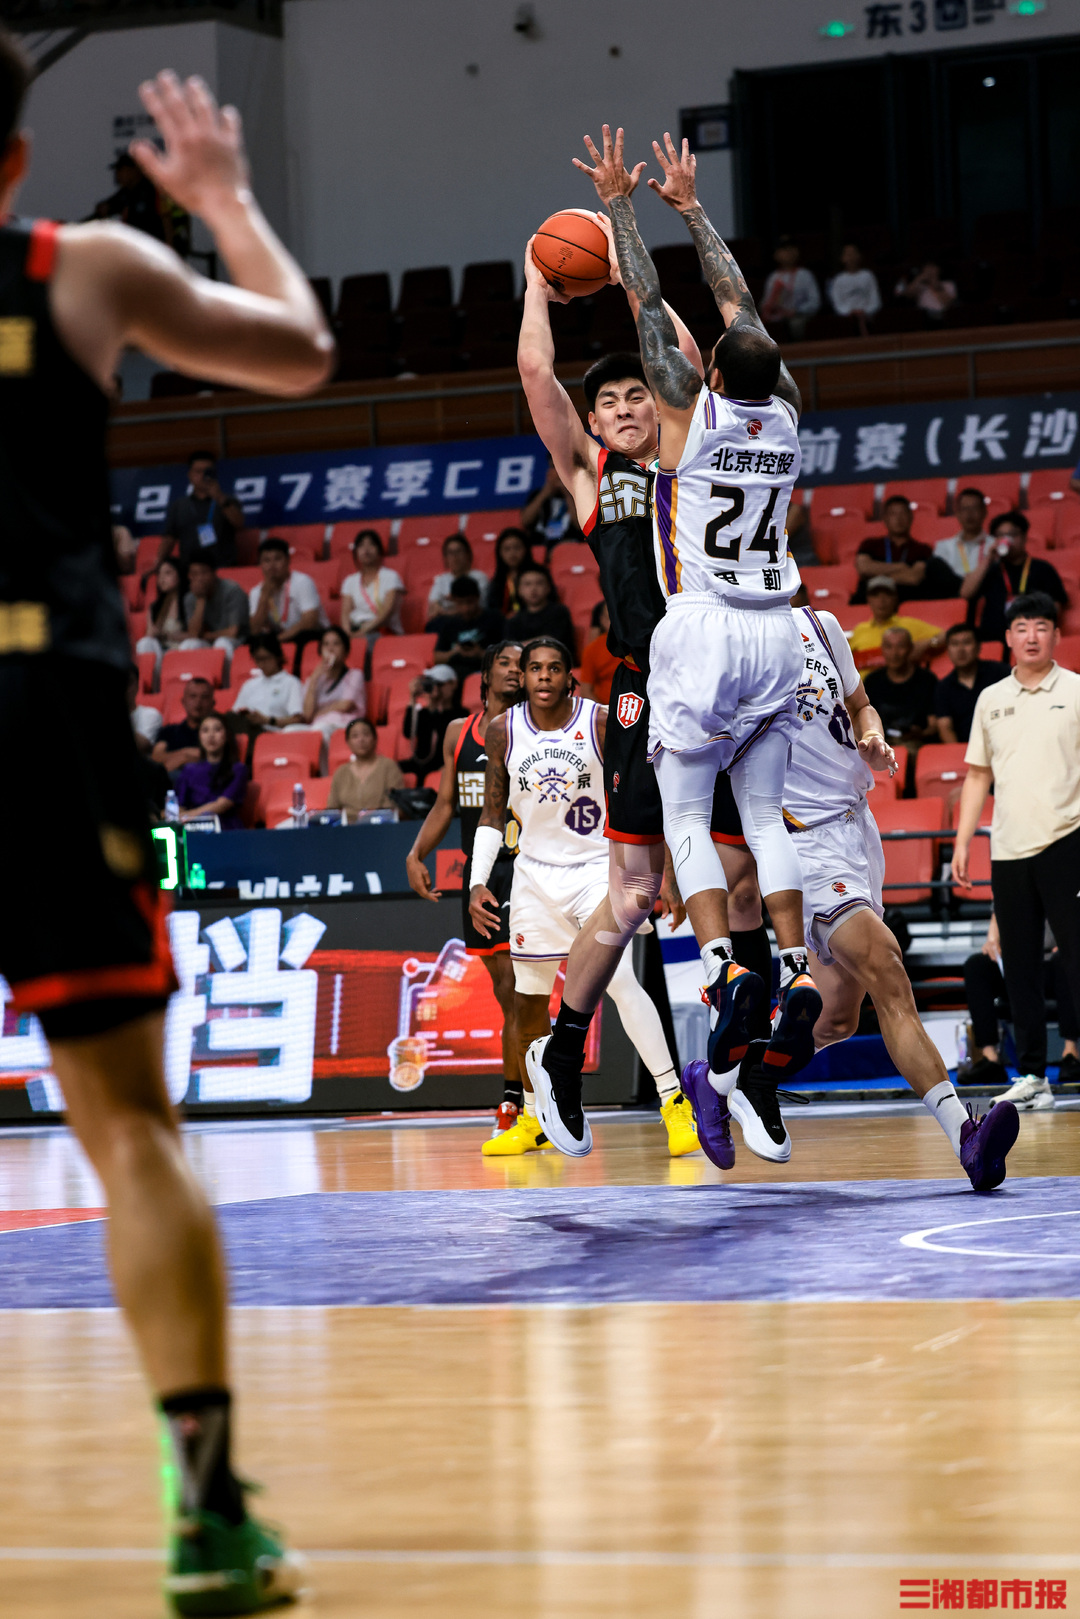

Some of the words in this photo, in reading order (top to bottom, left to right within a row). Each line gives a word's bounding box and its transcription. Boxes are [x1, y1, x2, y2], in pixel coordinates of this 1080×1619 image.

[710, 447, 795, 475] 北京控股
[704, 482, 781, 564] 24
[803, 657, 829, 677] ERS
[518, 751, 544, 775] ROYAL
[544, 748, 588, 772] FIGHTERS
[518, 777, 531, 792] 北
[577, 773, 591, 789] 京
[572, 804, 595, 829] 15
